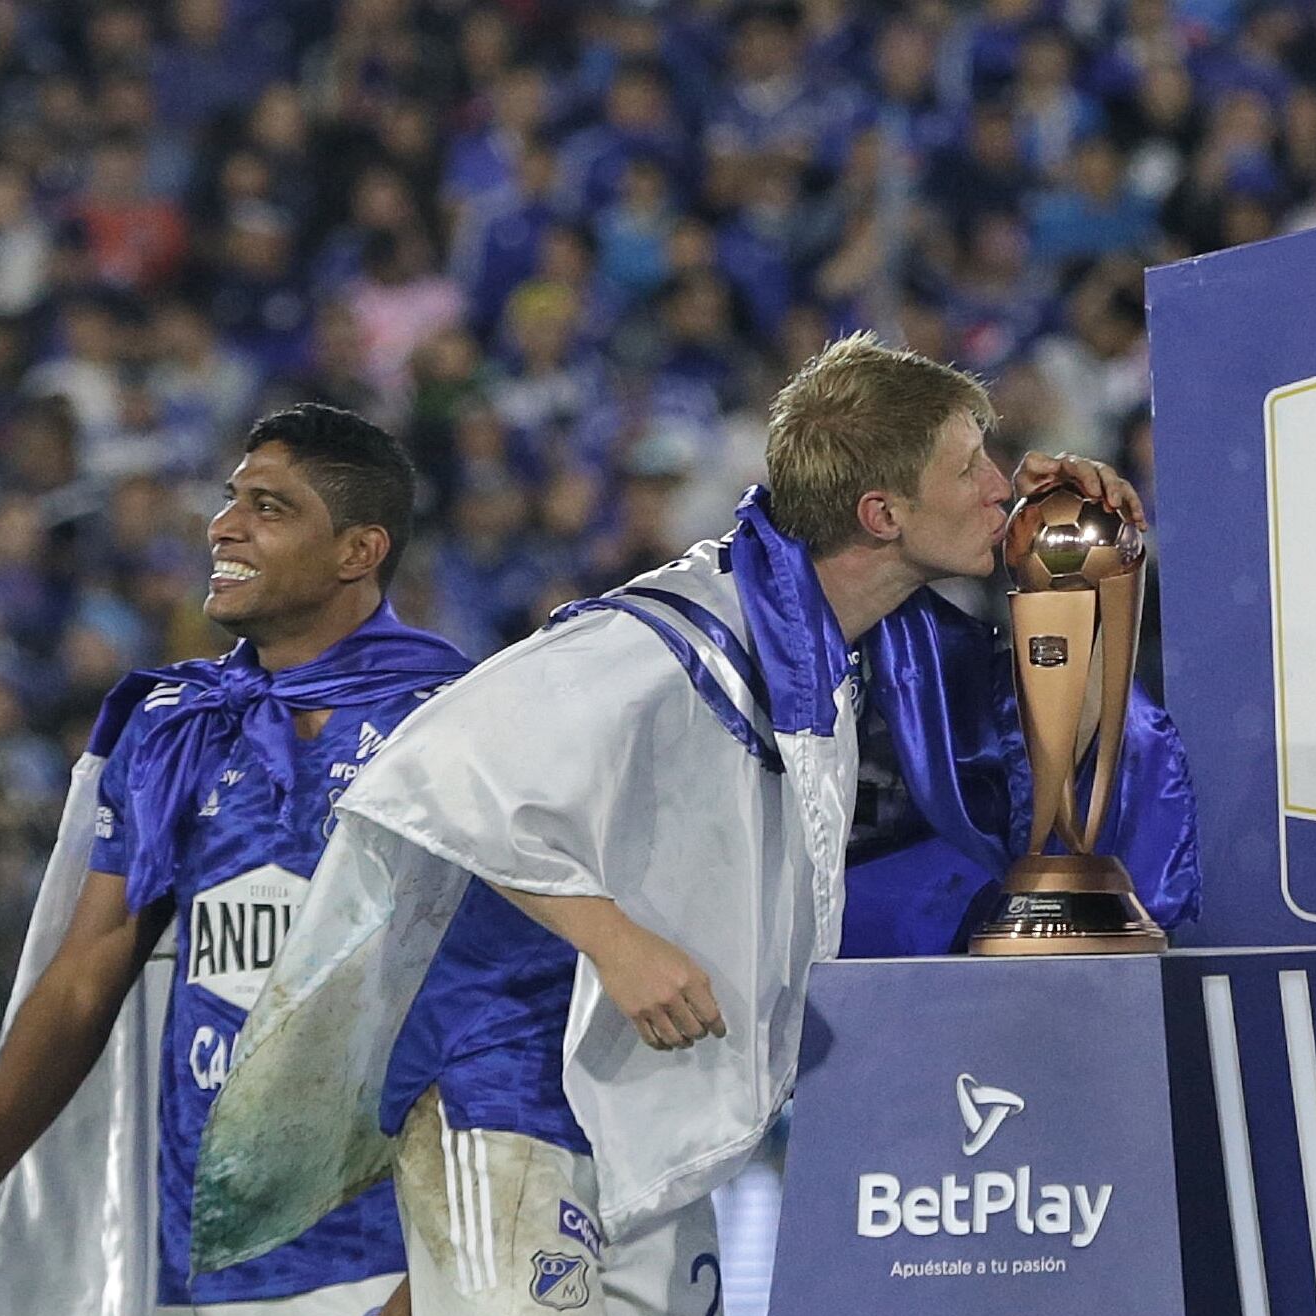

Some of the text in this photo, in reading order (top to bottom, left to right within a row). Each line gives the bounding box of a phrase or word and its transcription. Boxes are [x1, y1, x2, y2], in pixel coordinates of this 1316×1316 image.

[193, 902, 290, 977] AND
[857, 1166, 1112, 1247] BetPlay
[890, 1256, 1066, 1279] Apuéstale a tu pasión
